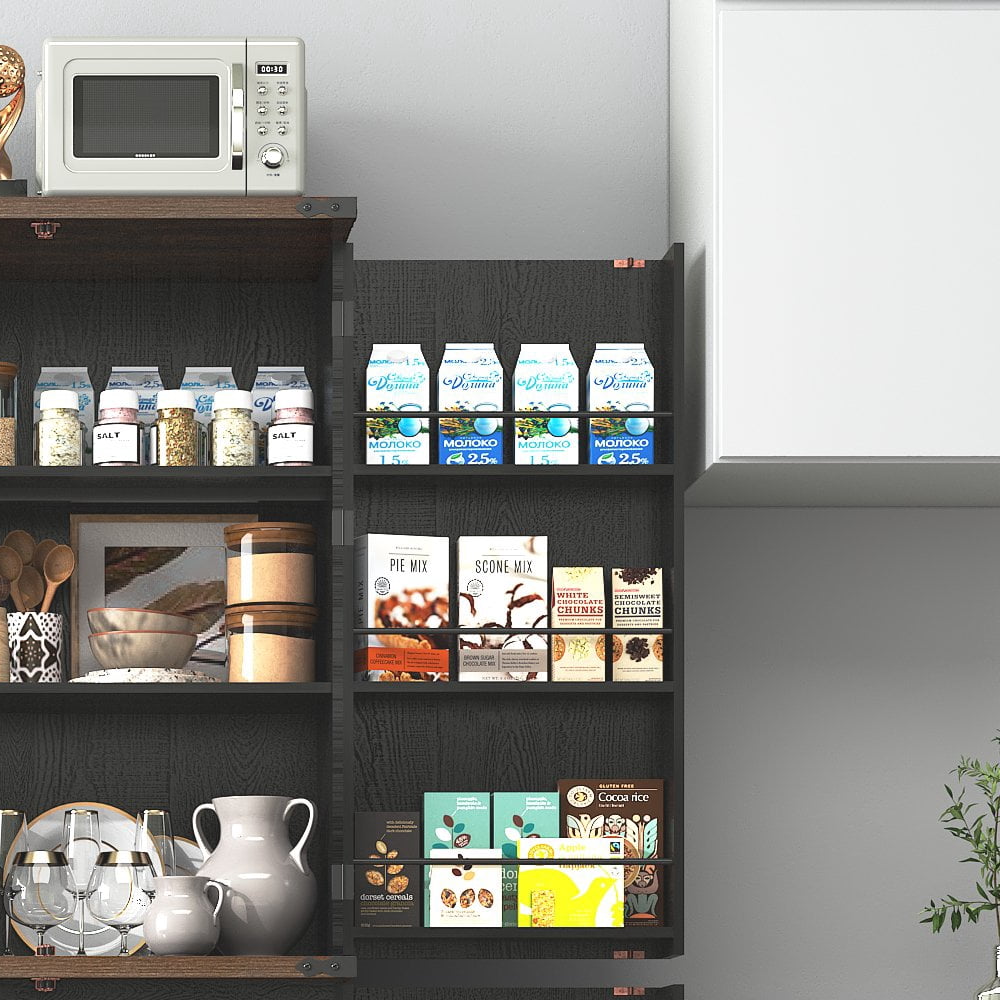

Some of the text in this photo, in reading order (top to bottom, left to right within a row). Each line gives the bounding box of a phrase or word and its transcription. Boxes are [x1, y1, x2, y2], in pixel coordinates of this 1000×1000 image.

[261, 65, 283, 73] 00:30
[97, 432, 120, 440] SALT
[272, 432, 296, 440] SALT
[443, 439, 498, 447] МОЛОКО
[518, 440, 571, 448] МОЛОКО
[594, 439, 649, 447] МОЛОКО
[390, 558, 428, 573] PIE MIX
[475, 560, 532, 574] SCONE MIX
[598, 792, 629, 802] Cocoa
[632, 792, 649, 802] rice
